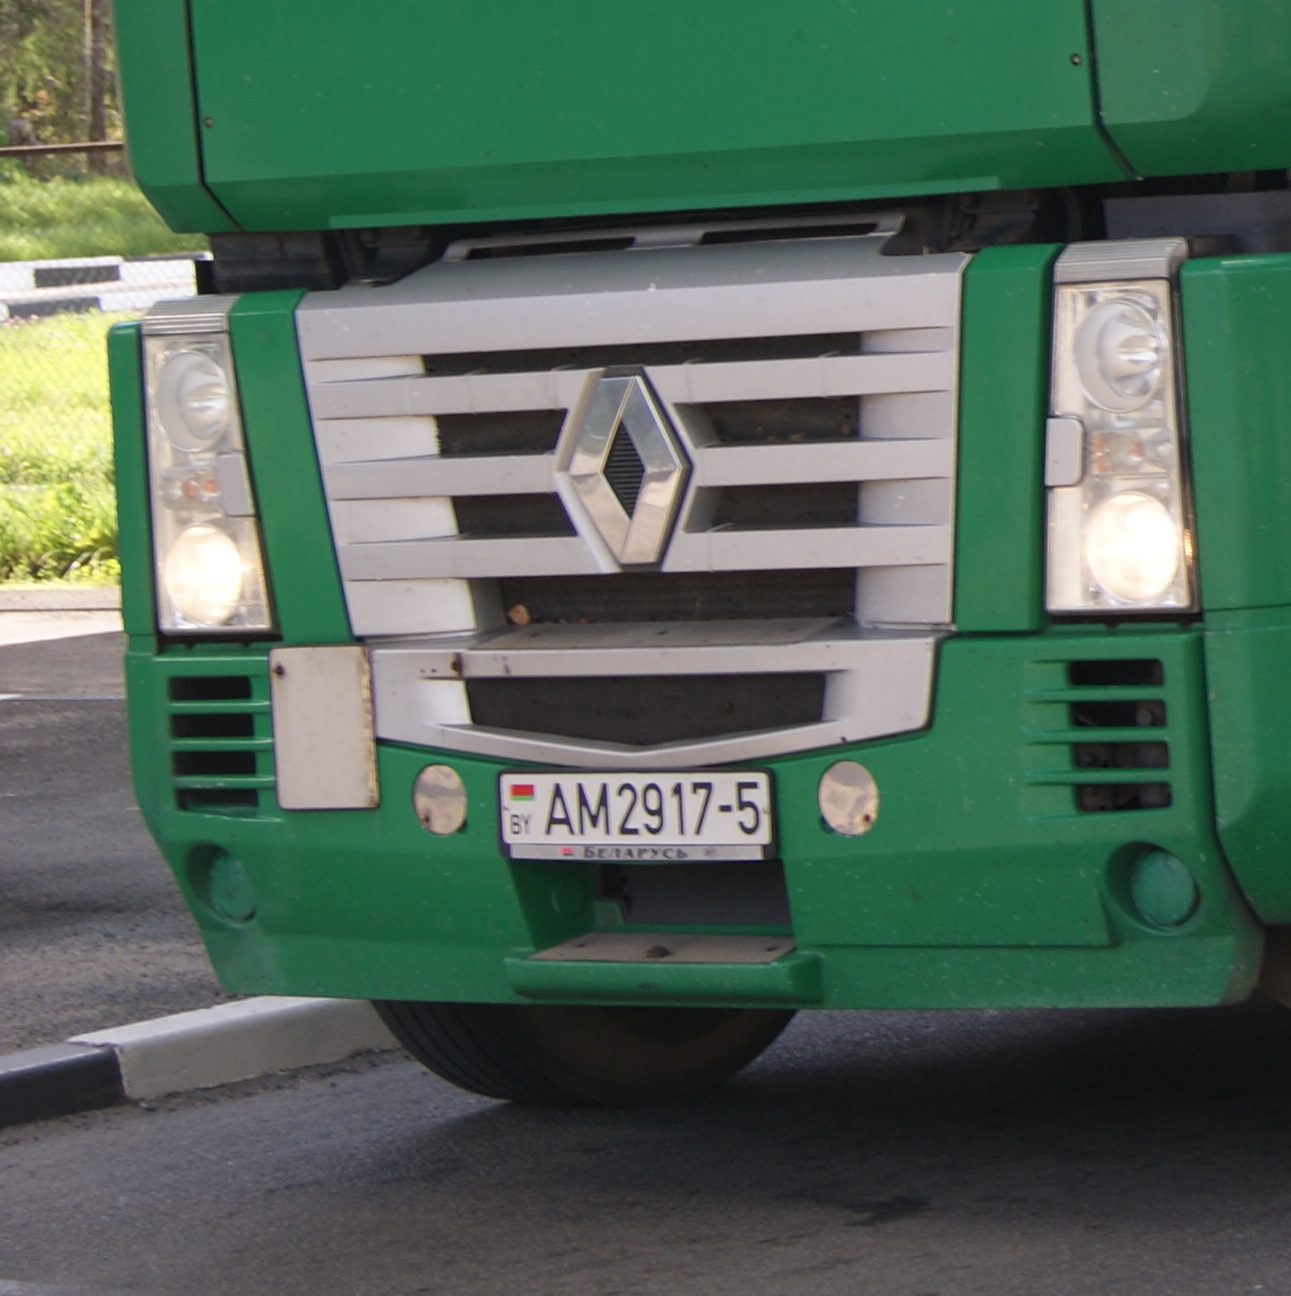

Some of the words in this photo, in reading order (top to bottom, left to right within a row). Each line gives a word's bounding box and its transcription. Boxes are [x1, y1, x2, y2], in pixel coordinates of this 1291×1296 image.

[509, 813, 532, 835] BY
[545, 781, 760, 836] AM2917-5
[582, 846, 689, 859] БЕЛАРУСЬ
